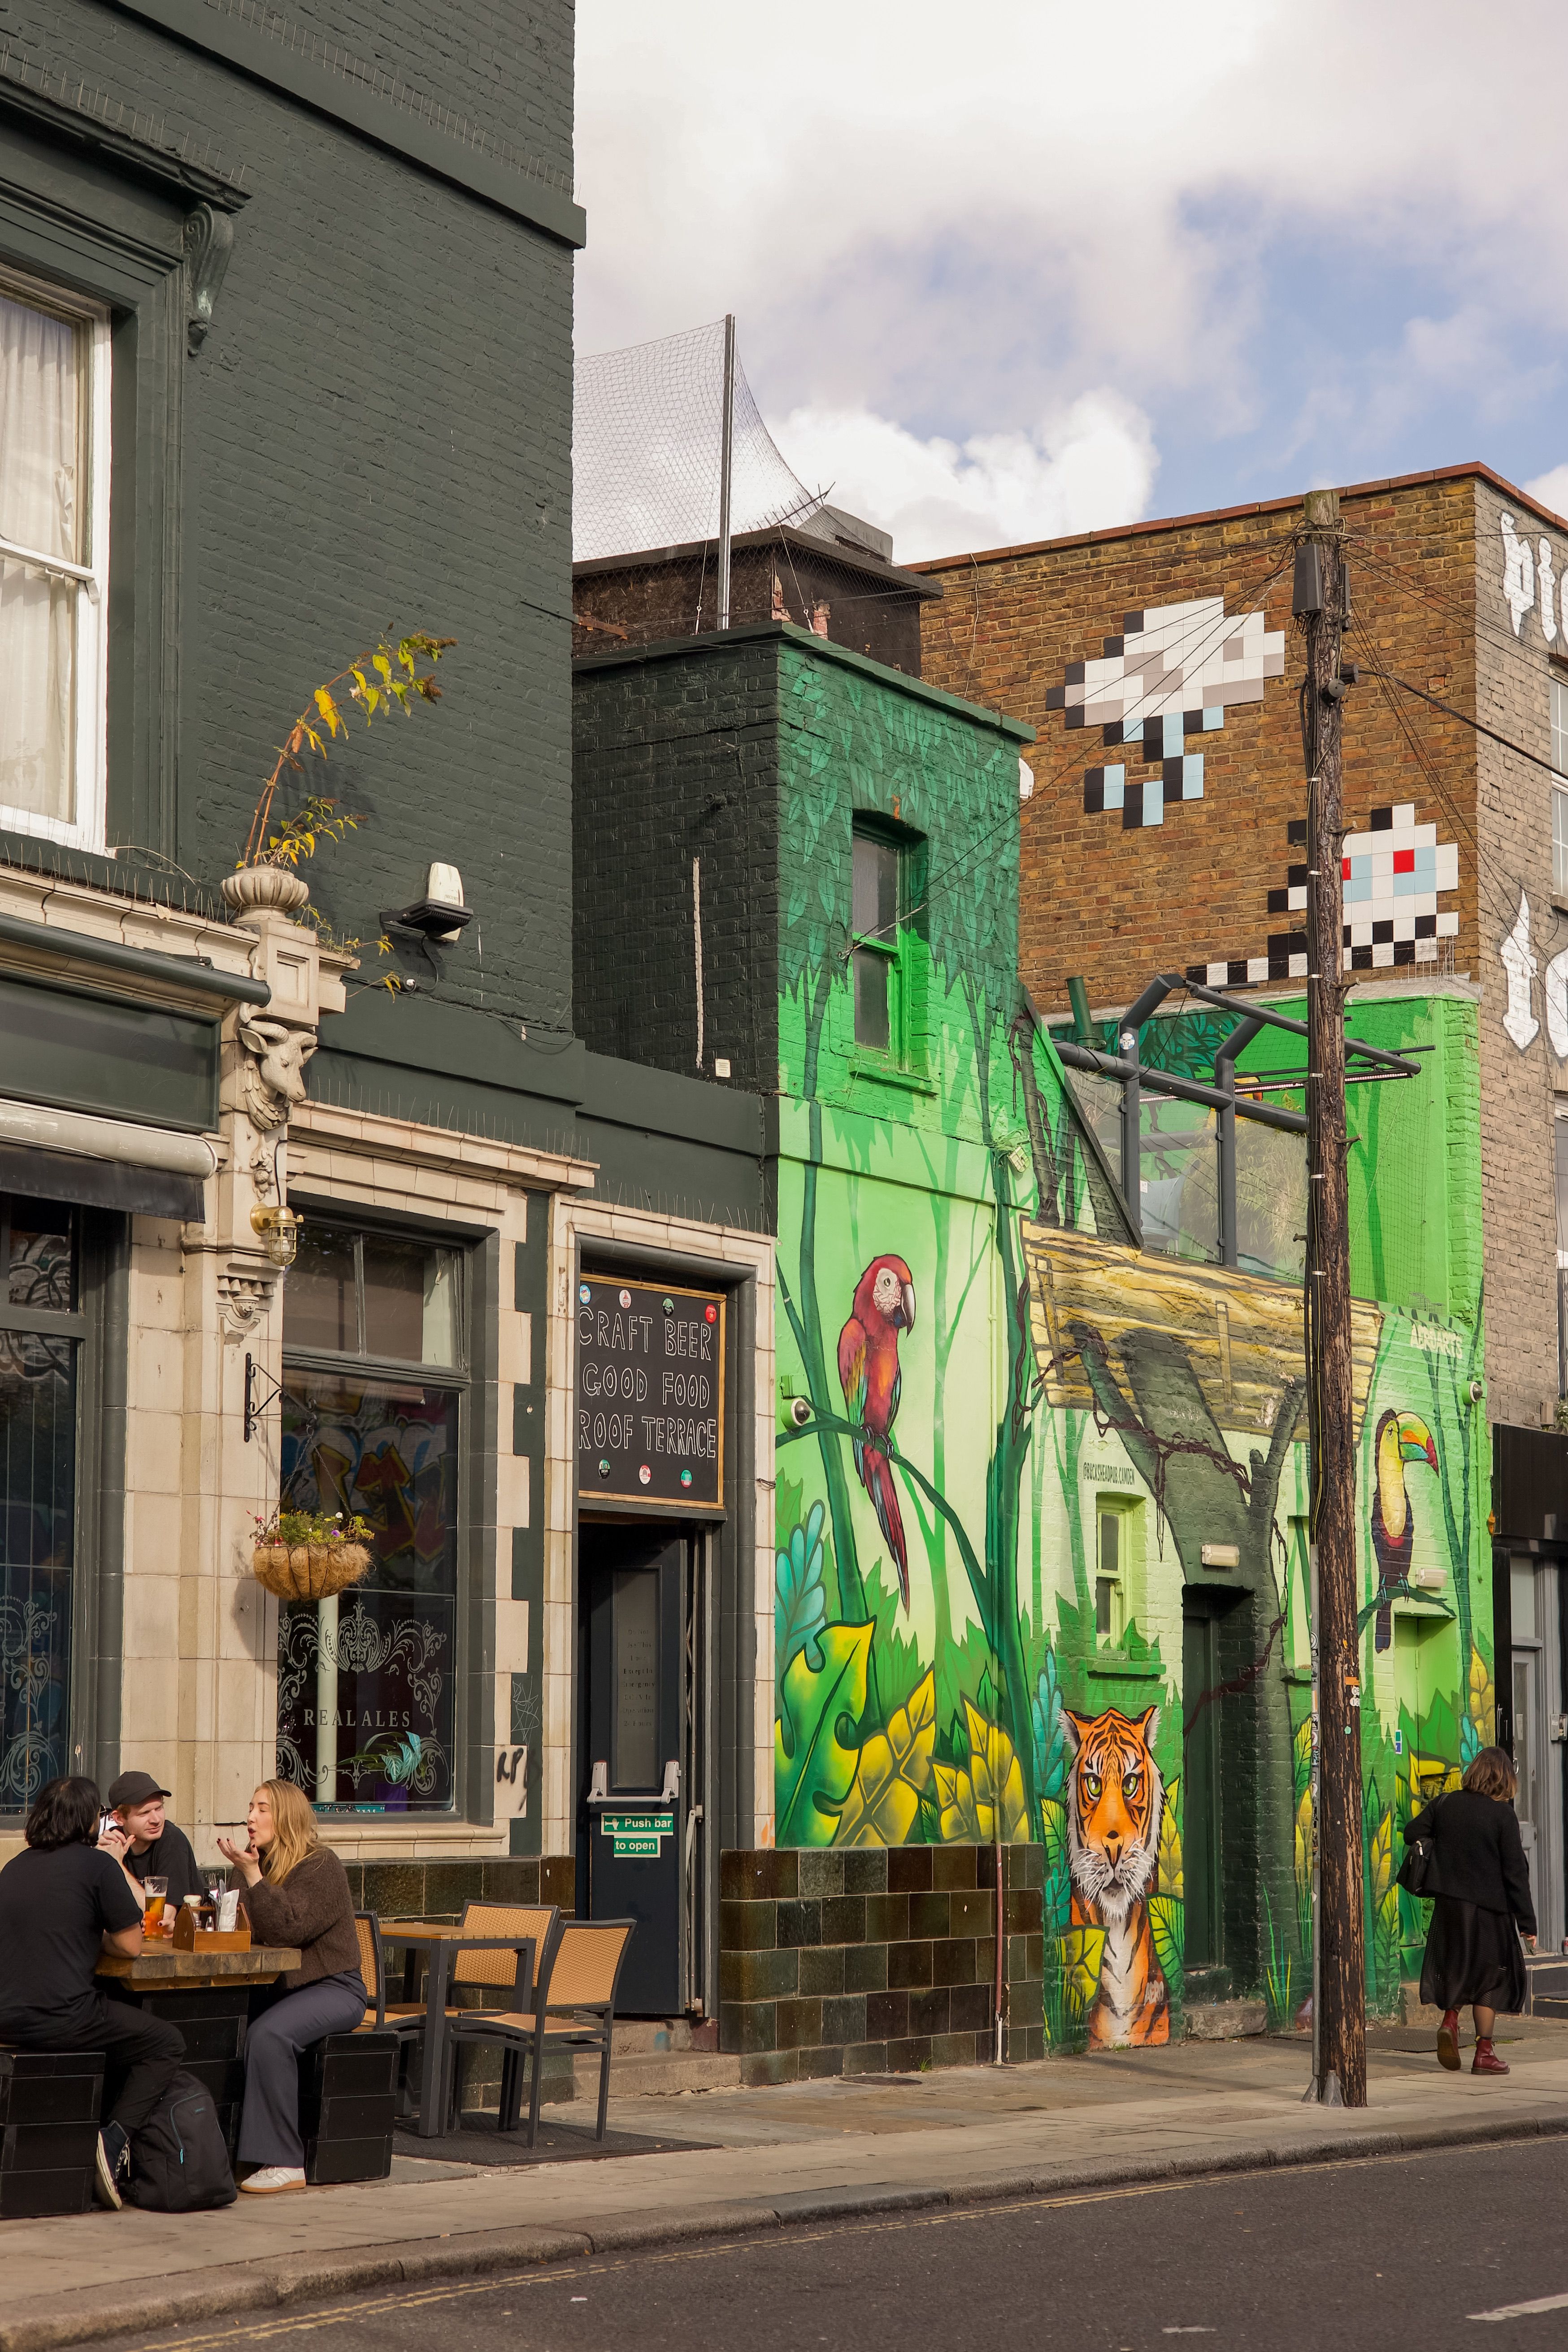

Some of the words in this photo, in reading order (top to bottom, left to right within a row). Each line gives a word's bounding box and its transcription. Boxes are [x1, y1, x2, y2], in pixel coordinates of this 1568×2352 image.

[579, 1306, 653, 1353] CRAFT
[665, 1318, 712, 1361] BEER
[582, 1363, 648, 1402] GOOD
[662, 1372, 710, 1409] FOOD
[578, 1409, 633, 1450] ROOF
[641, 1415, 716, 1458] TERRACE
[1083, 1462, 1135, 1485] @BUCKSHEADPUB.CAMDEN
[304, 1709, 356, 1726] REAL
[361, 1710, 409, 1727] ALES
[625, 1818, 651, 1828] Push
[655, 1818, 672, 1828] bar
[615, 1841, 626, 1850] to
[629, 1842, 655, 1852] open
